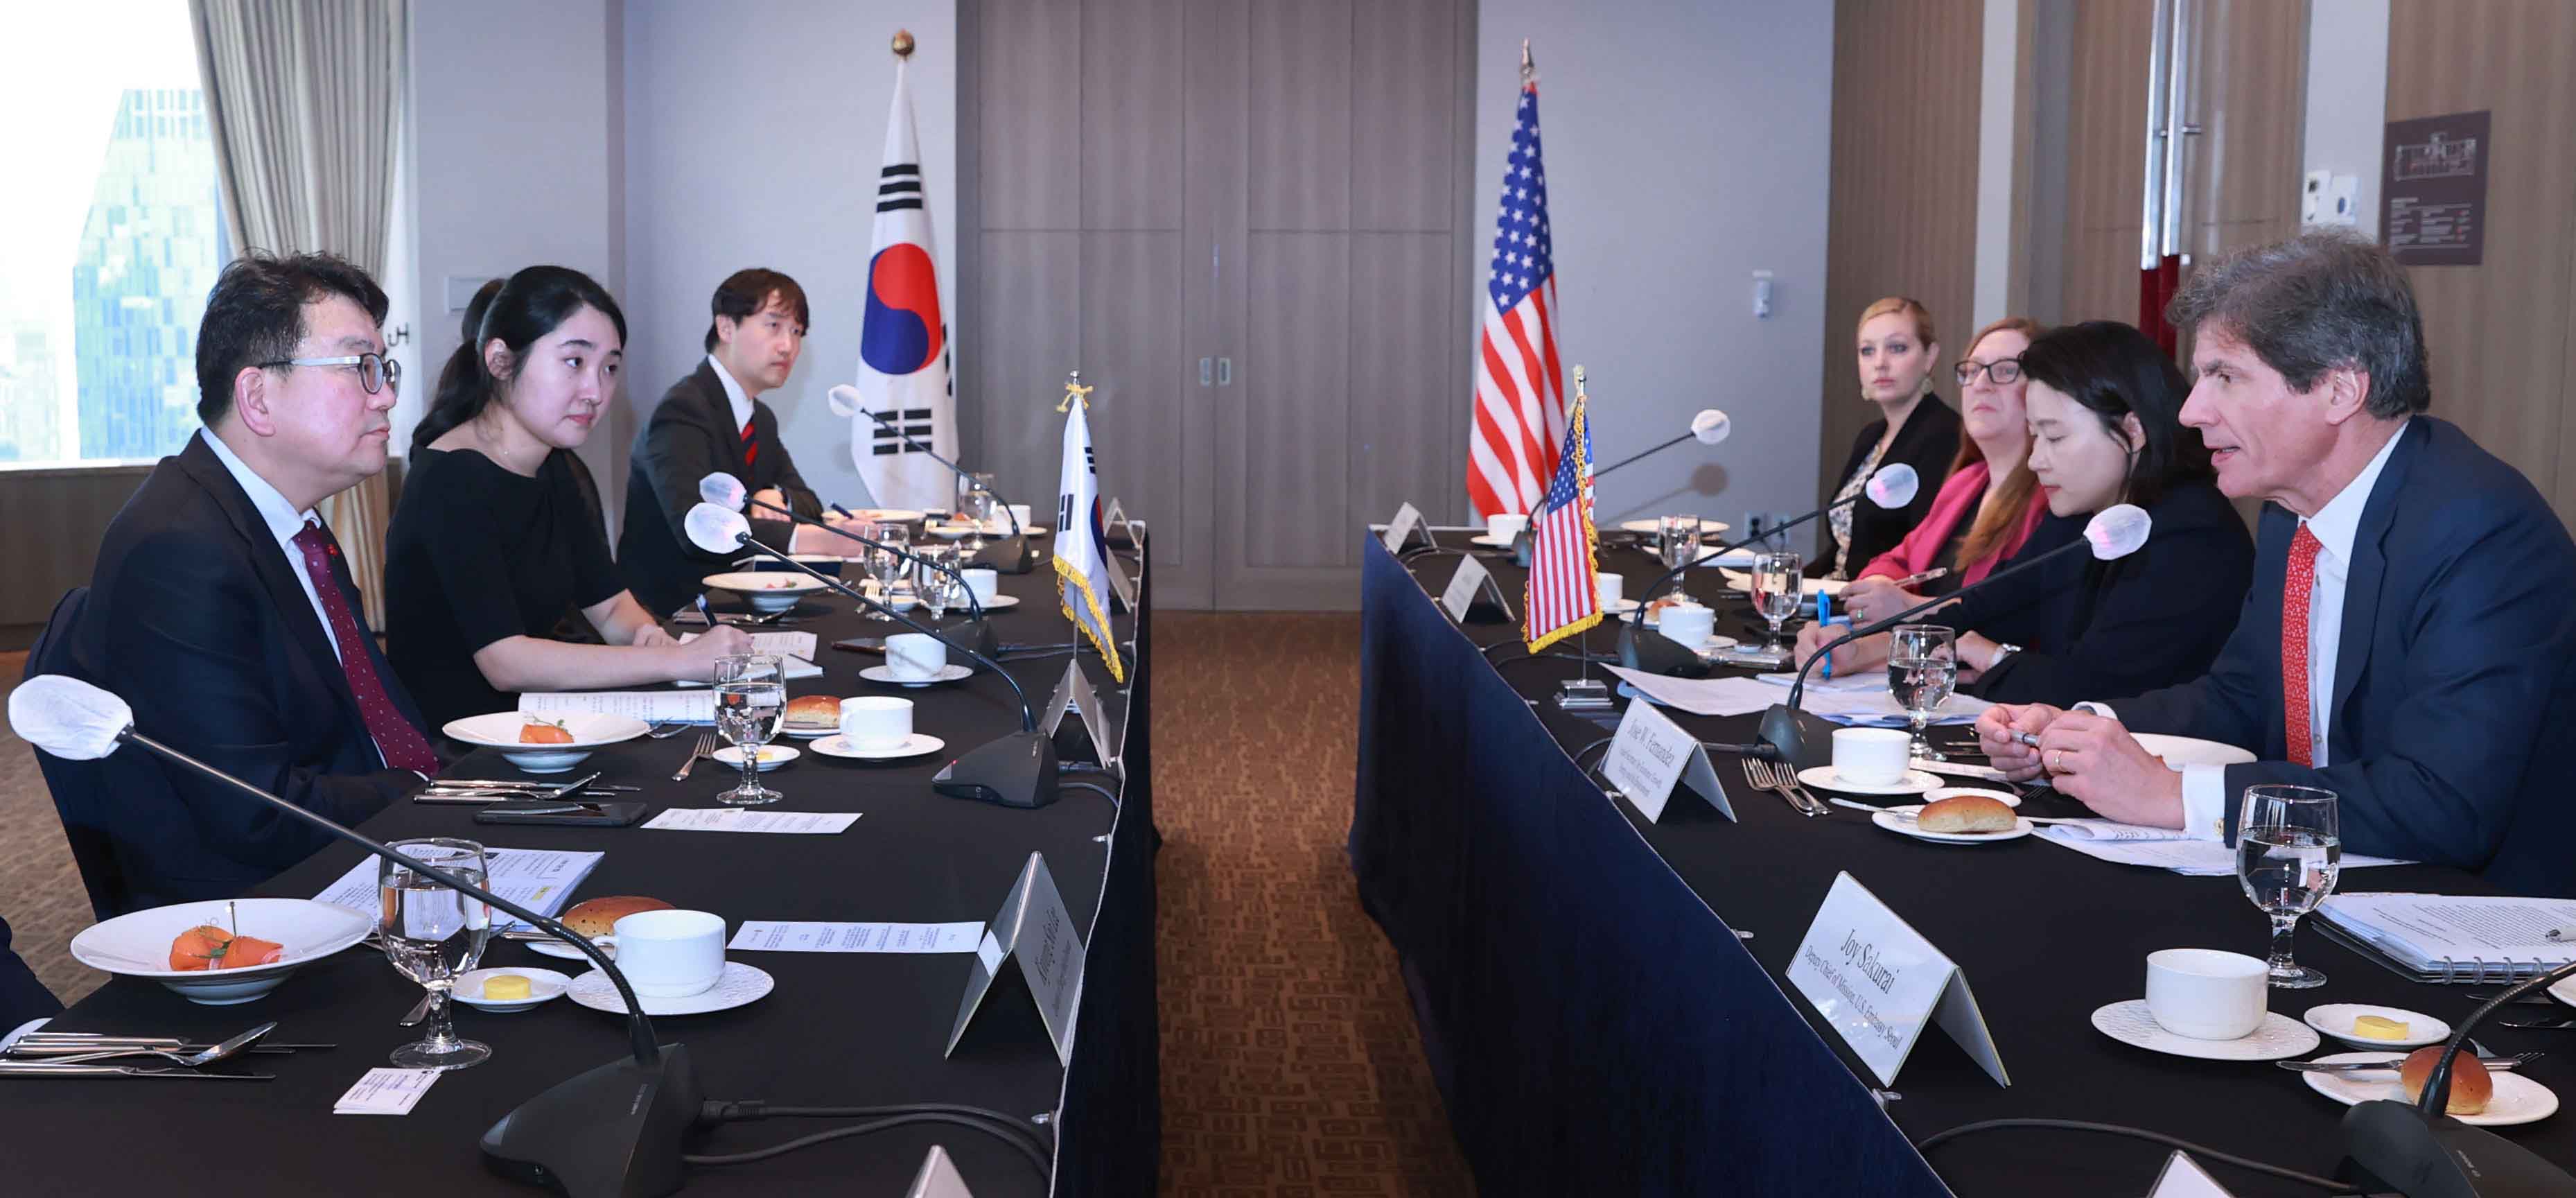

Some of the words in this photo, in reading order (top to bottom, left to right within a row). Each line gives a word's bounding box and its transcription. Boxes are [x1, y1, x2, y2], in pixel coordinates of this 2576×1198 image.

[1841, 928, 1861, 966] Joy
[1857, 944, 1900, 995] Sakurai
[1884, 1026, 1902, 1050] Seoul
